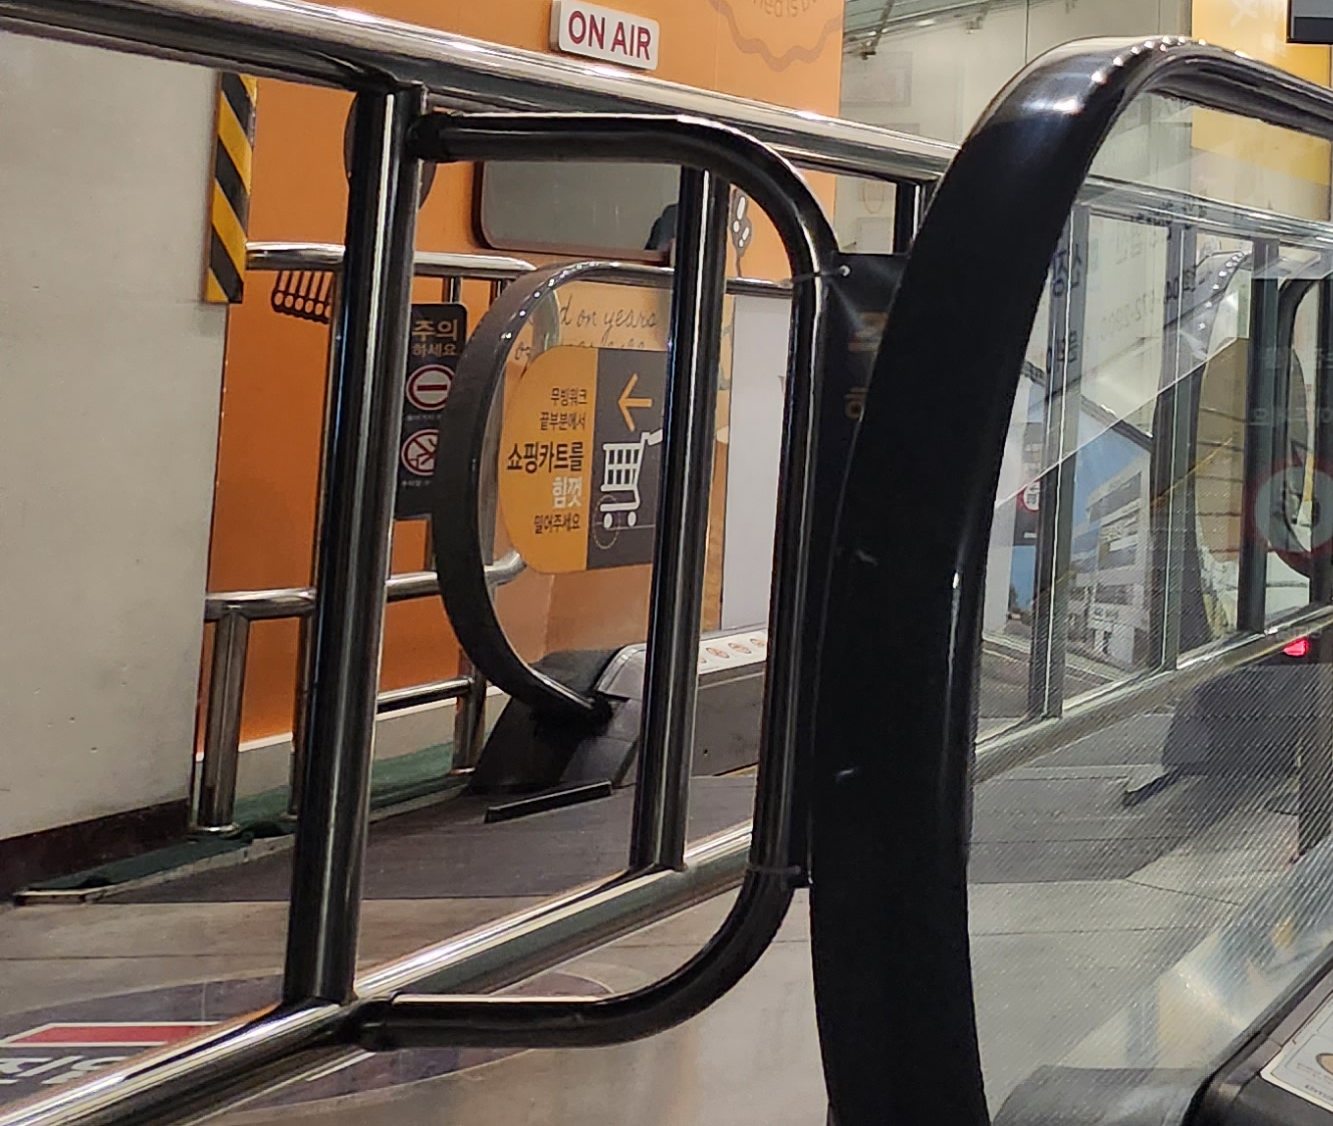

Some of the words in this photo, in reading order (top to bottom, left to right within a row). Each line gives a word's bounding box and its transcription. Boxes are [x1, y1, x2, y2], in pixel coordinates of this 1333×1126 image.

[568, 10, 605, 49] ON
[610, 21, 652, 61] AIR
[412, 319, 458, 340] 주의
[412, 343, 457, 358] 하세요
[550, 387, 588, 406] 무빙워크
[539, 411, 586, 432] 끝부분에서
[507, 441, 585, 474] 쇼핑카트를
[552, 476, 583, 509] 힘껏
[534, 512, 581, 534] 밀어주세요
